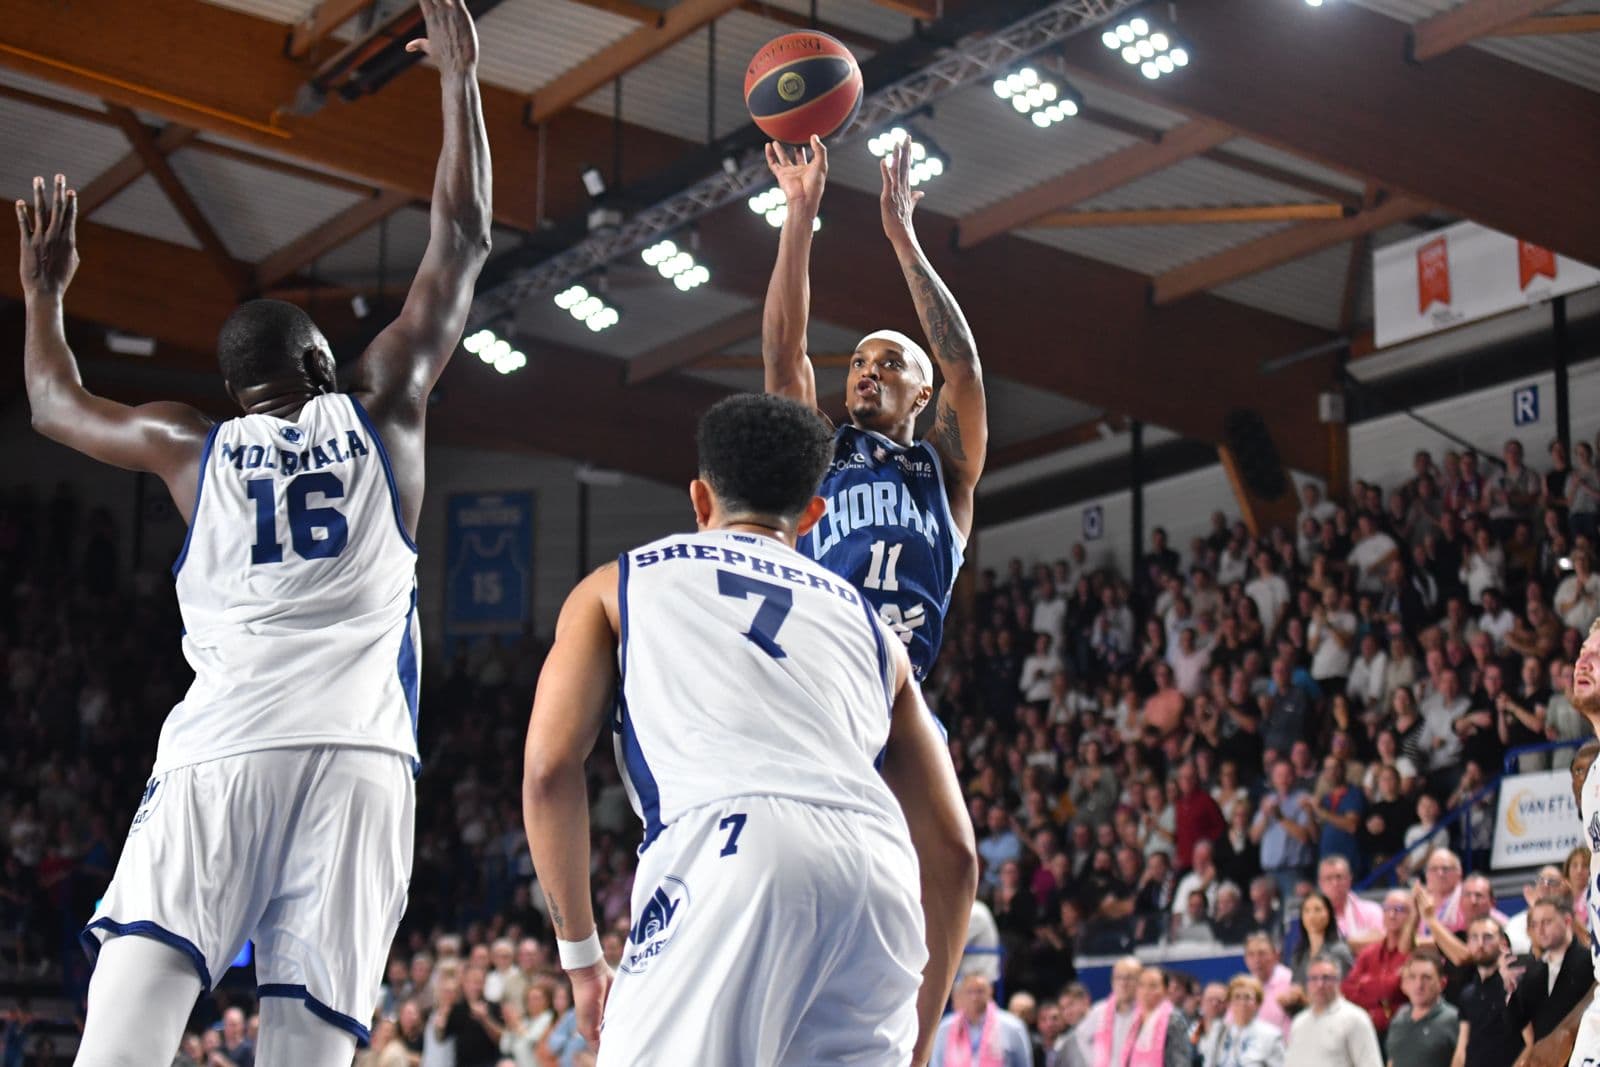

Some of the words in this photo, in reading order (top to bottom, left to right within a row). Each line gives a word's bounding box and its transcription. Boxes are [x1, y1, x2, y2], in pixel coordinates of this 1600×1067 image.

[1518, 389, 1535, 421] R
[247, 472, 348, 565] 16
[635, 544, 859, 606] SHEPHERD
[863, 540, 903, 591] 11
[716, 569, 793, 659] 7
[1519, 799, 1545, 814] VAN
[1548, 795, 1565, 812] ET
[719, 813, 747, 858] 7
